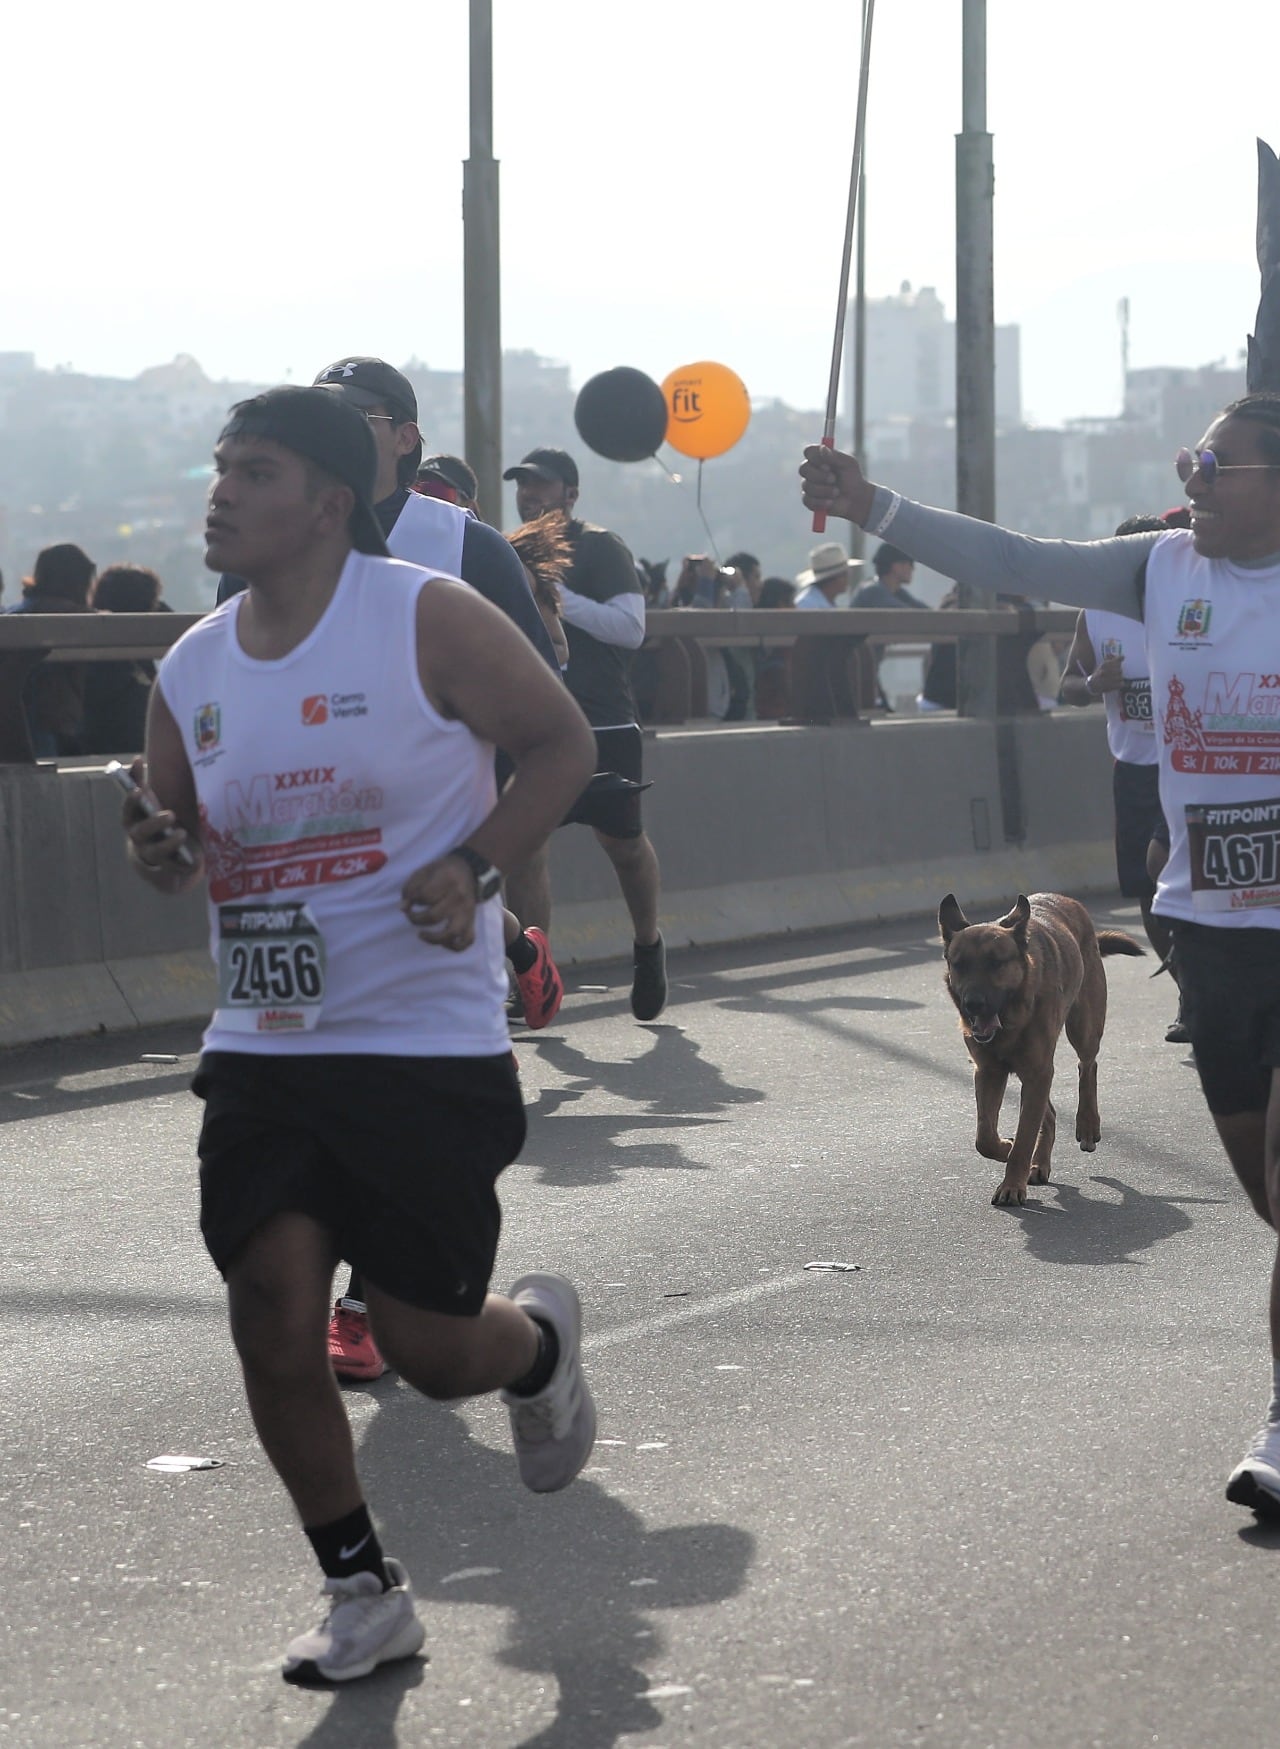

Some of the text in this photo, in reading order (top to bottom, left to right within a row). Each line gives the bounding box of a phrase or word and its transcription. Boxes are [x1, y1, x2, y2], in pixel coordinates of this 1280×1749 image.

[673, 388, 701, 414] fit
[331, 693, 366, 706] Cerro
[331, 705, 369, 719] Verde
[1183, 755, 1197, 769] 5k
[1213, 756, 1239, 770] 10k
[274, 767, 336, 790] XXXIX
[240, 909, 297, 929] FITPOINT
[227, 939, 324, 1004] 2456
